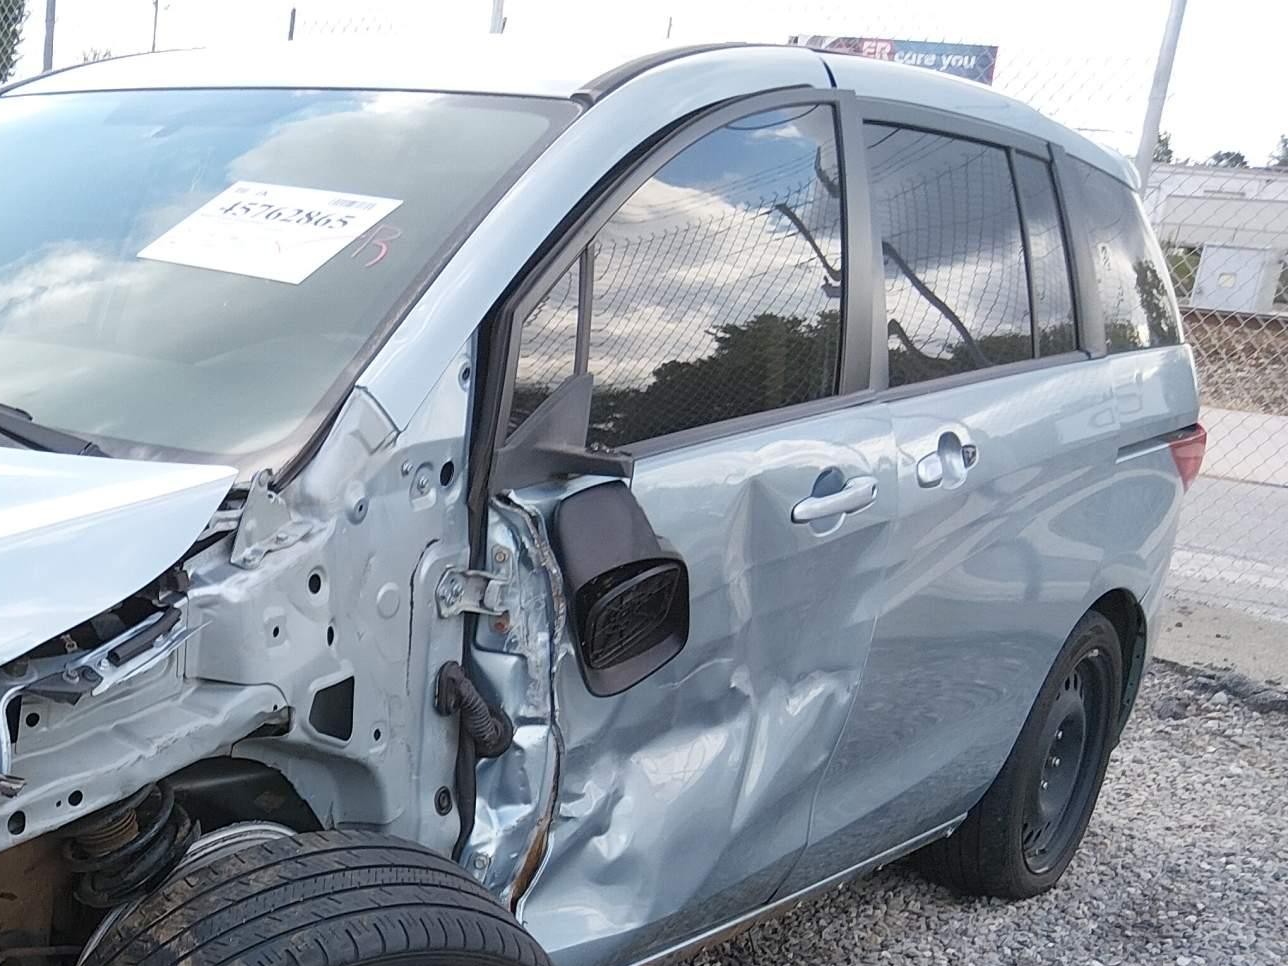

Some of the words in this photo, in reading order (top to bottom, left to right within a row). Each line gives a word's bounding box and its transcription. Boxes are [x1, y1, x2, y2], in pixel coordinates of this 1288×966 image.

[894, 49, 937, 66] care
[941, 53, 976, 71] you
[219, 200, 356, 229] 45762865
